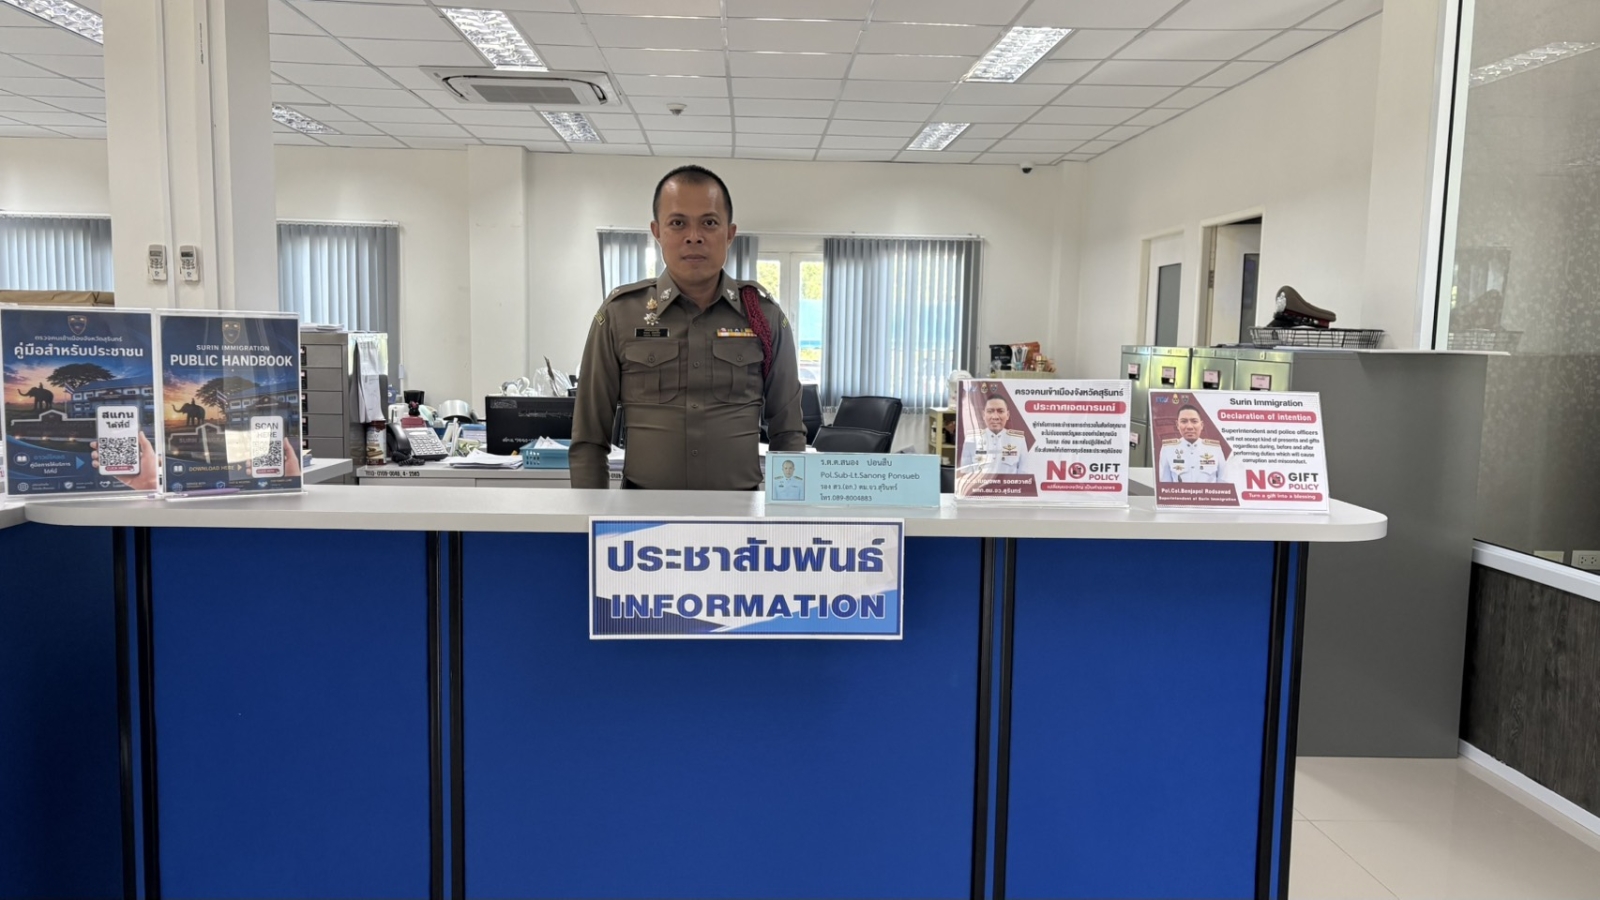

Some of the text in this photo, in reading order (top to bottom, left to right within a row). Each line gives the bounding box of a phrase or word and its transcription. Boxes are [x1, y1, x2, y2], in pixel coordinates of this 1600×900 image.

[14, 342, 144, 359] คู่มือสำหรับประชาชน
[170, 354, 293, 367] PUBLIC HANDBOOK
[1229, 398, 1303, 408] Surin Immigration
[102, 410, 134, 419] สแกน
[1220, 412, 1264, 420] Declaration
[254, 422, 279, 430] SCAN
[1089, 463, 1120, 472] GIFT
[1288, 472, 1318, 482] GIFT
[607, 537, 885, 572] ประชาสัมพันธ์
[611, 594, 885, 618] INFORMATION
